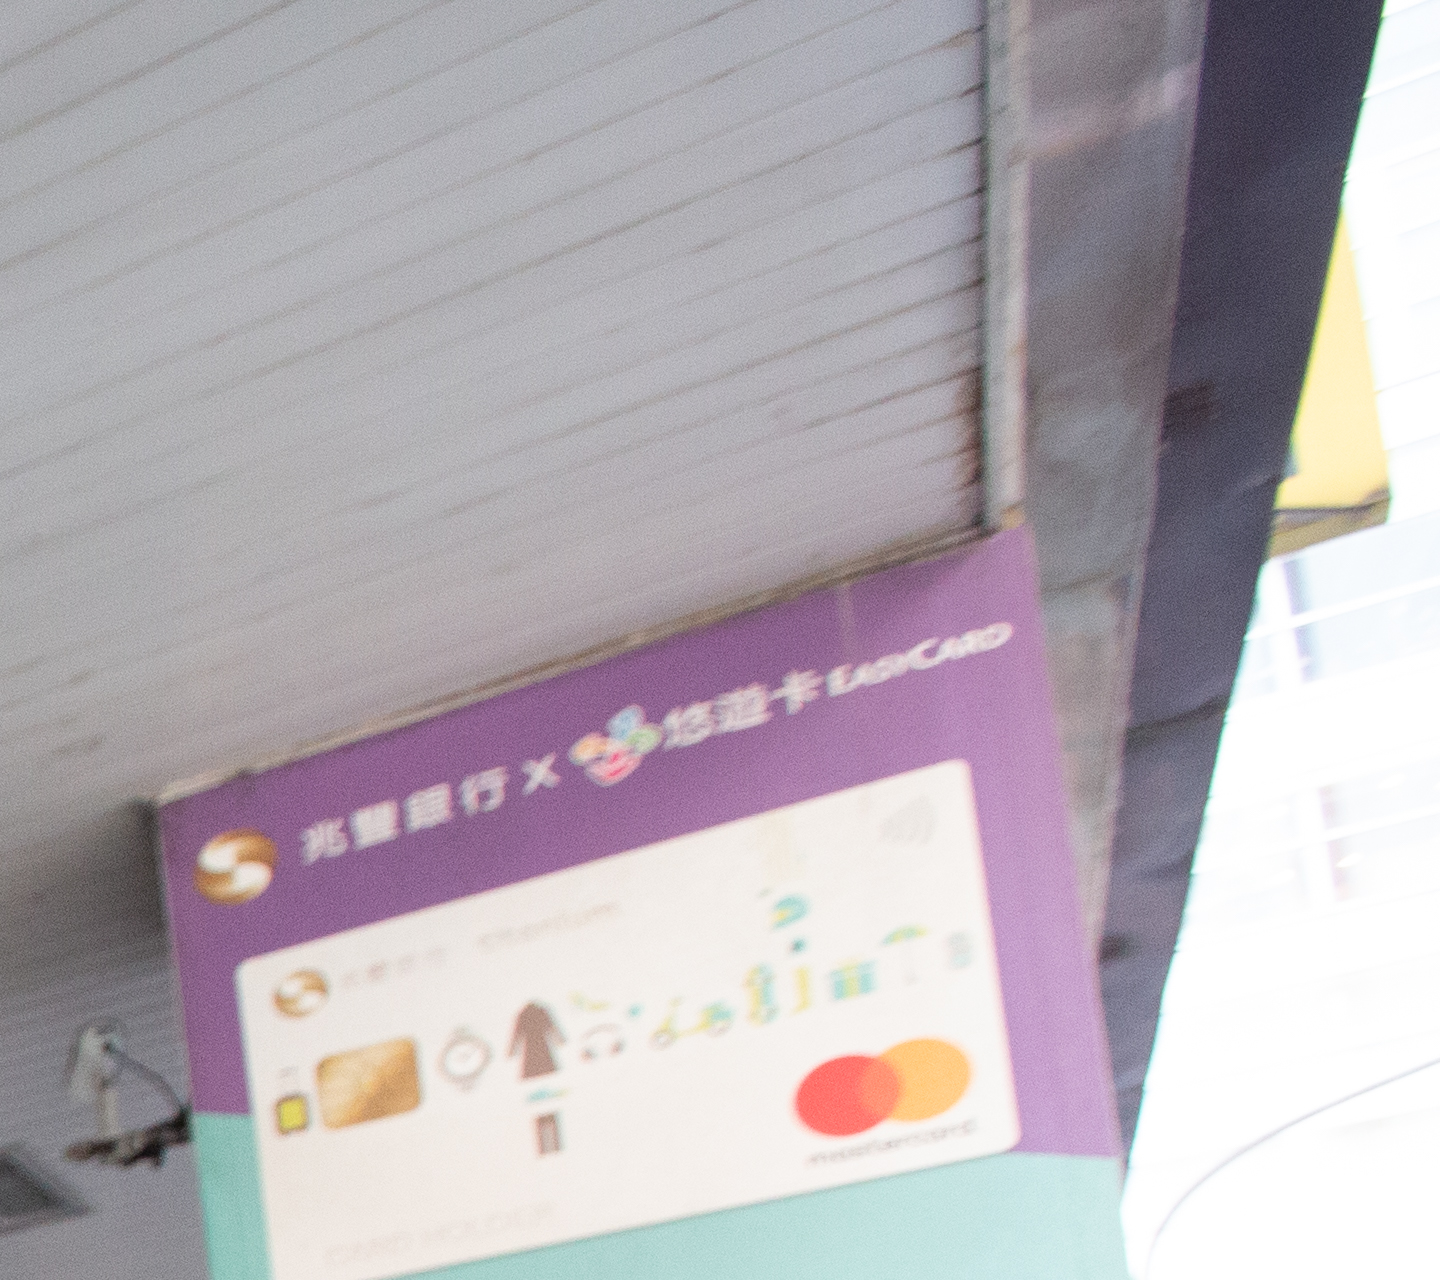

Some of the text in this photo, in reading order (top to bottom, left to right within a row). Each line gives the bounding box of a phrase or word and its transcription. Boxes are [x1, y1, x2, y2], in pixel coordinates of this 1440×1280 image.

[300, 742, 510, 866] 兆豐銀行
[662, 669, 824, 750] 悠遊卡
